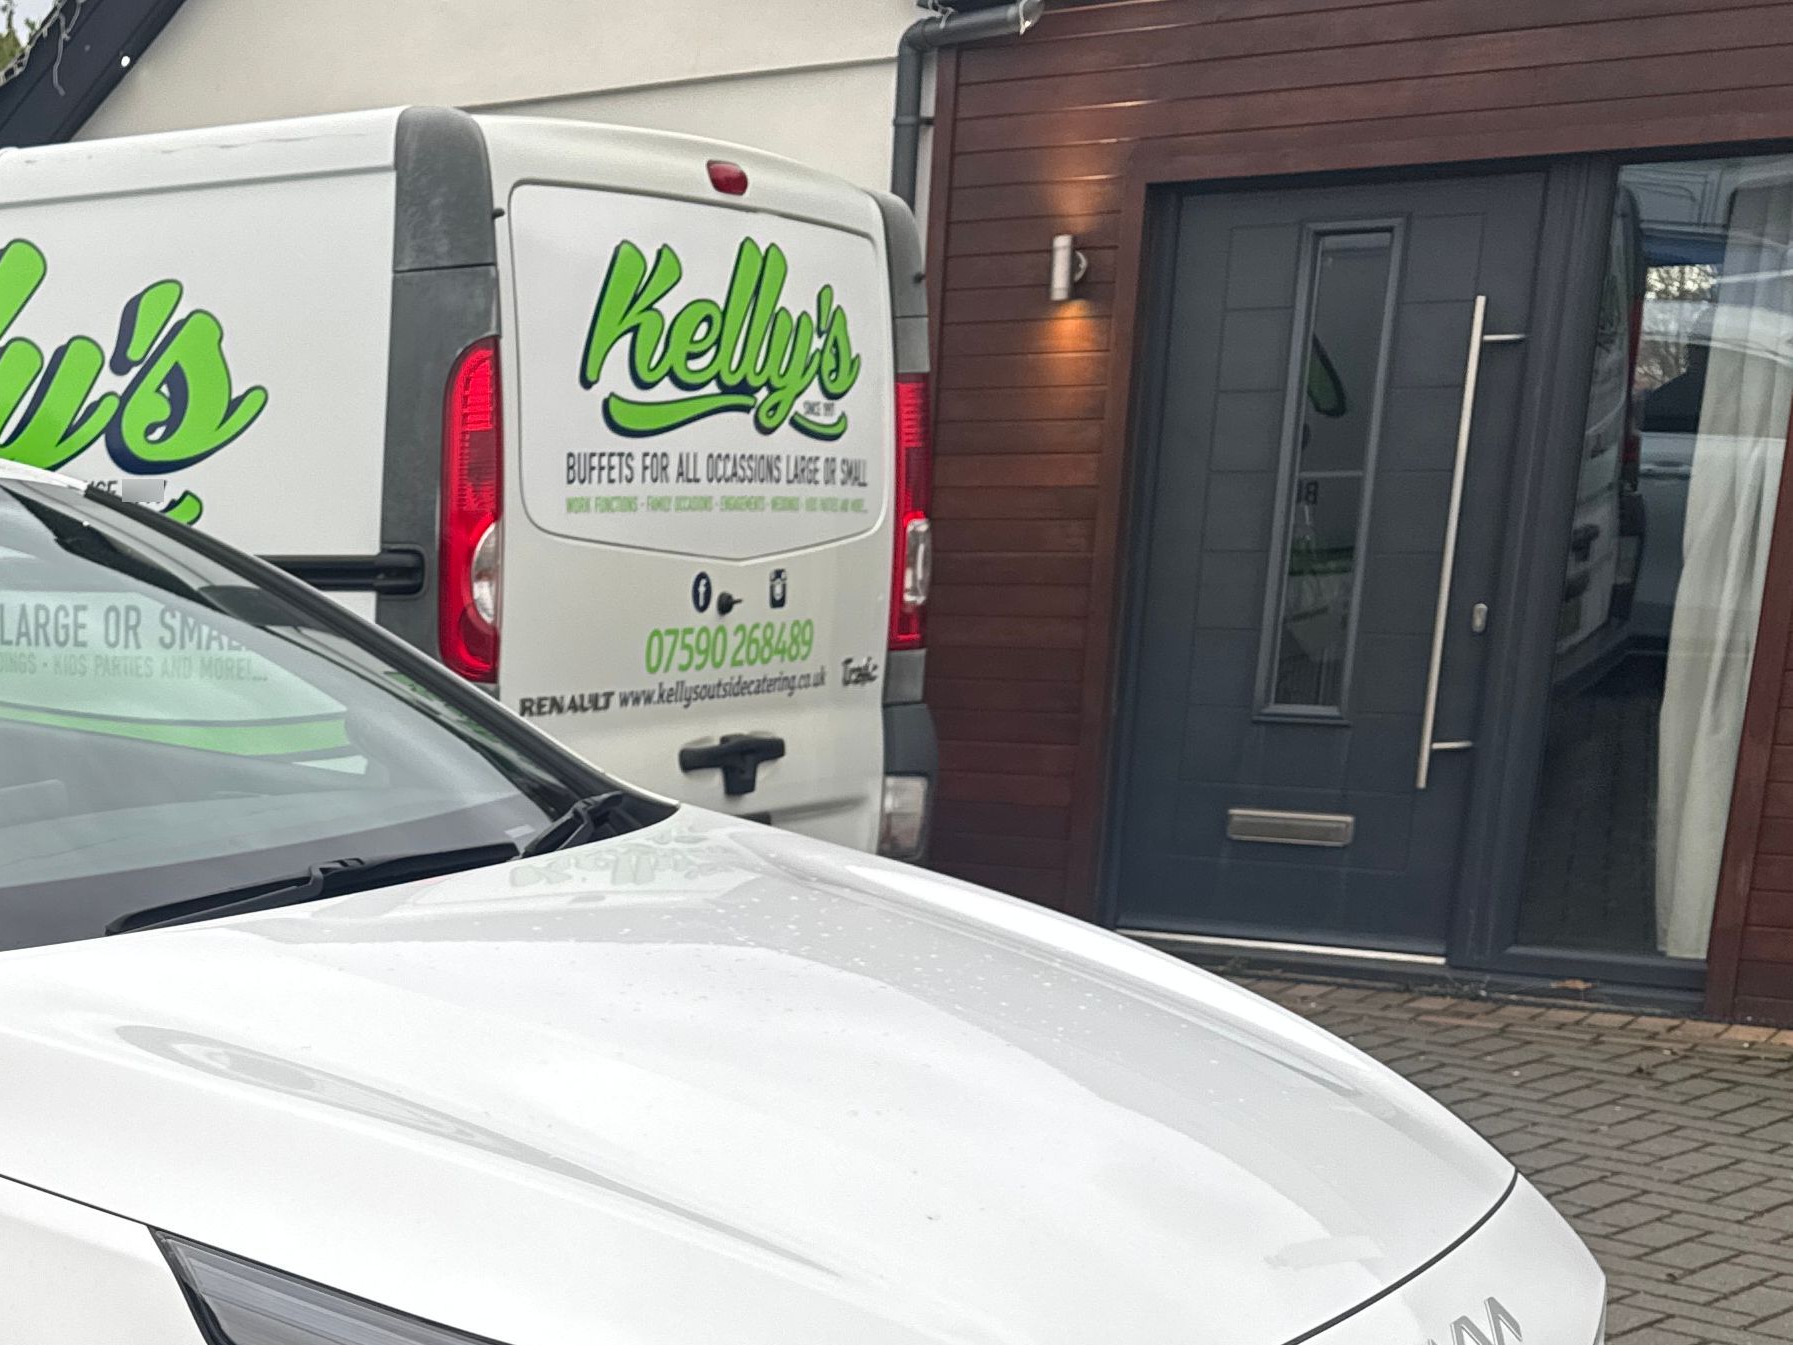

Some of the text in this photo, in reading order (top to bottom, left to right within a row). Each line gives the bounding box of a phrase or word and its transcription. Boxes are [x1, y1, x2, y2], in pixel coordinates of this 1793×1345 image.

[579, 236, 862, 435] Kelly's
[566, 452, 868, 488] BUFFETS FOR ALL OCCASSIONS LARGE OR SMALL
[0, 603, 88, 648] LARGE
[104, 604, 142, 650] OR
[645, 618, 815, 674] 07590 268489
[94, 654, 154, 679] PARTIES
[161, 656, 192, 679] AND
[619, 665, 826, 709] www.kellysoutsidecatering.co.uk
[519, 691, 615, 717] RENAULT
